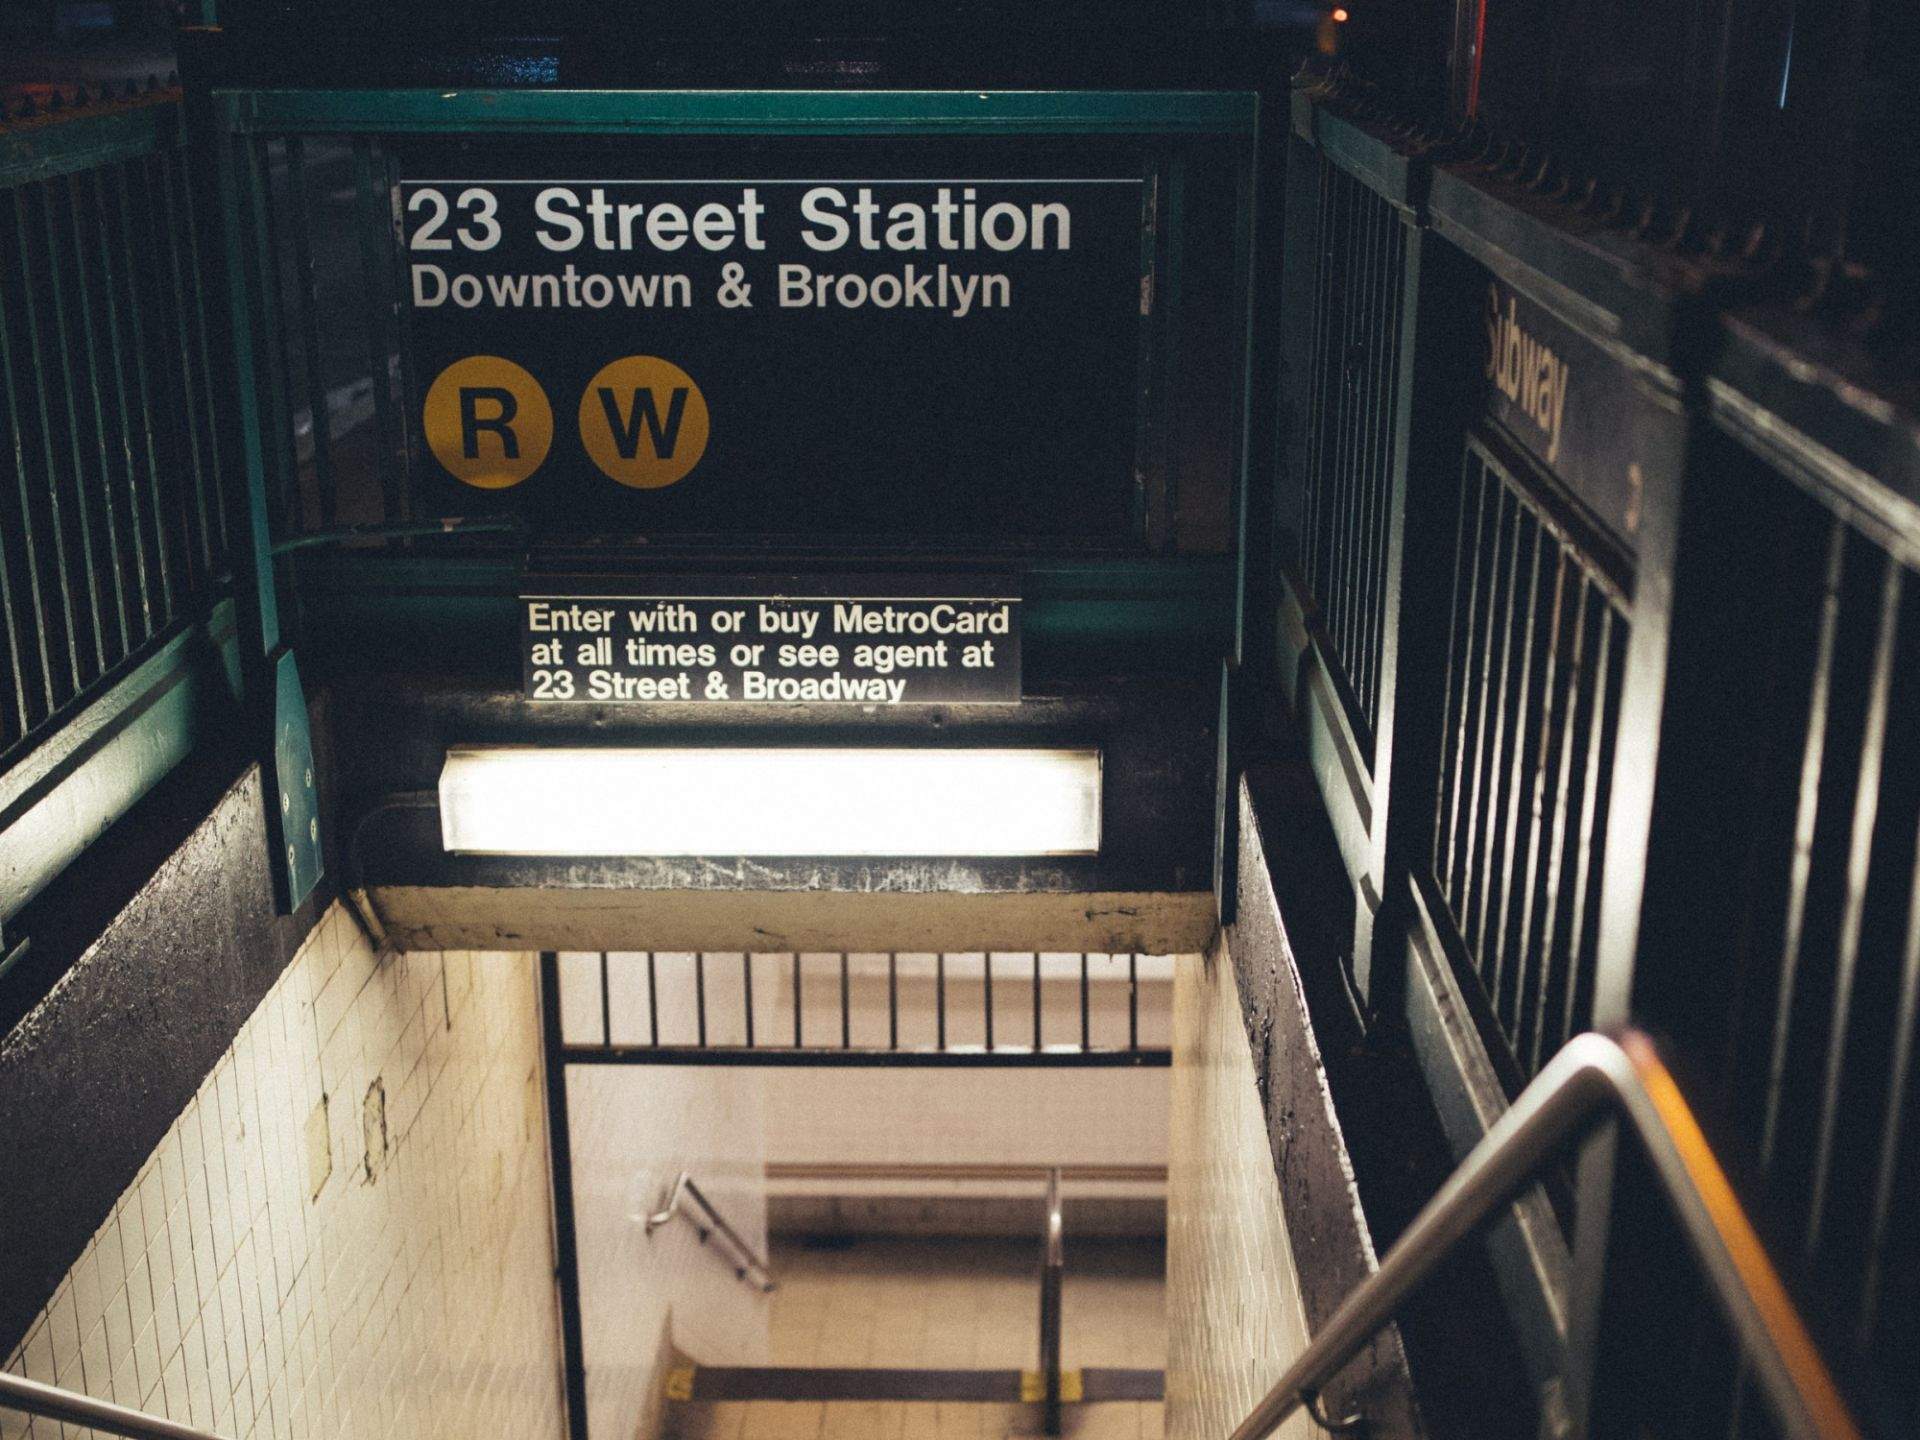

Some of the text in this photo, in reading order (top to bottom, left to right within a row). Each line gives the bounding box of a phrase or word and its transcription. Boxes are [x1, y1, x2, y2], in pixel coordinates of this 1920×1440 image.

[407, 187, 1071, 251] 23 Street Station
[411, 262, 1011, 318] Downtown & Brooklyn
[459, 387, 690, 459] R W
[528, 602, 1009, 639] Enter with or buy MetroCard
[531, 637, 994, 673] at all times or see agent at
[532, 670, 907, 704] 23 Street & Broadway
